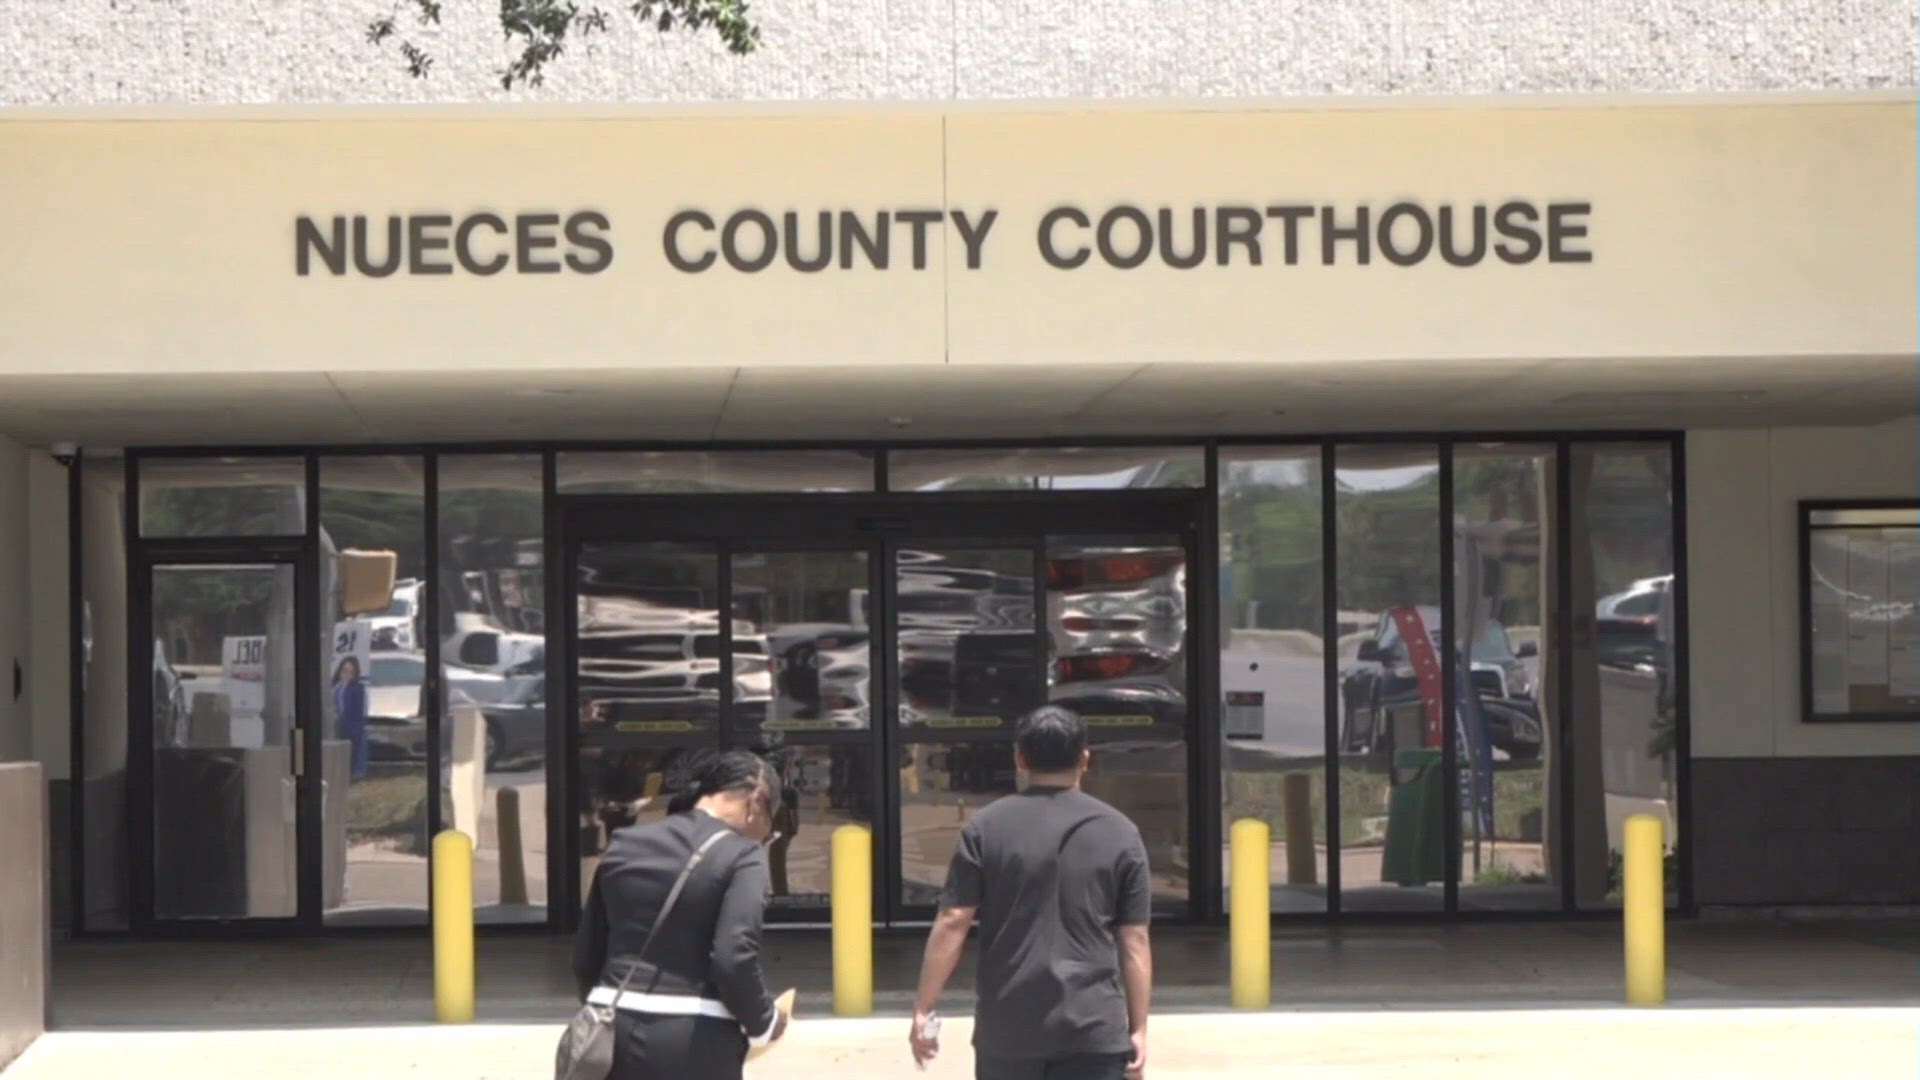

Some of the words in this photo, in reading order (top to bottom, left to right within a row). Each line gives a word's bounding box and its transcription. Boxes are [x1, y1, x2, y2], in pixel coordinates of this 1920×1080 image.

[296, 210, 614, 278] NUECES
[663, 208, 999, 274] COUNTY
[1037, 201, 1593, 270] COURTHOUSE
